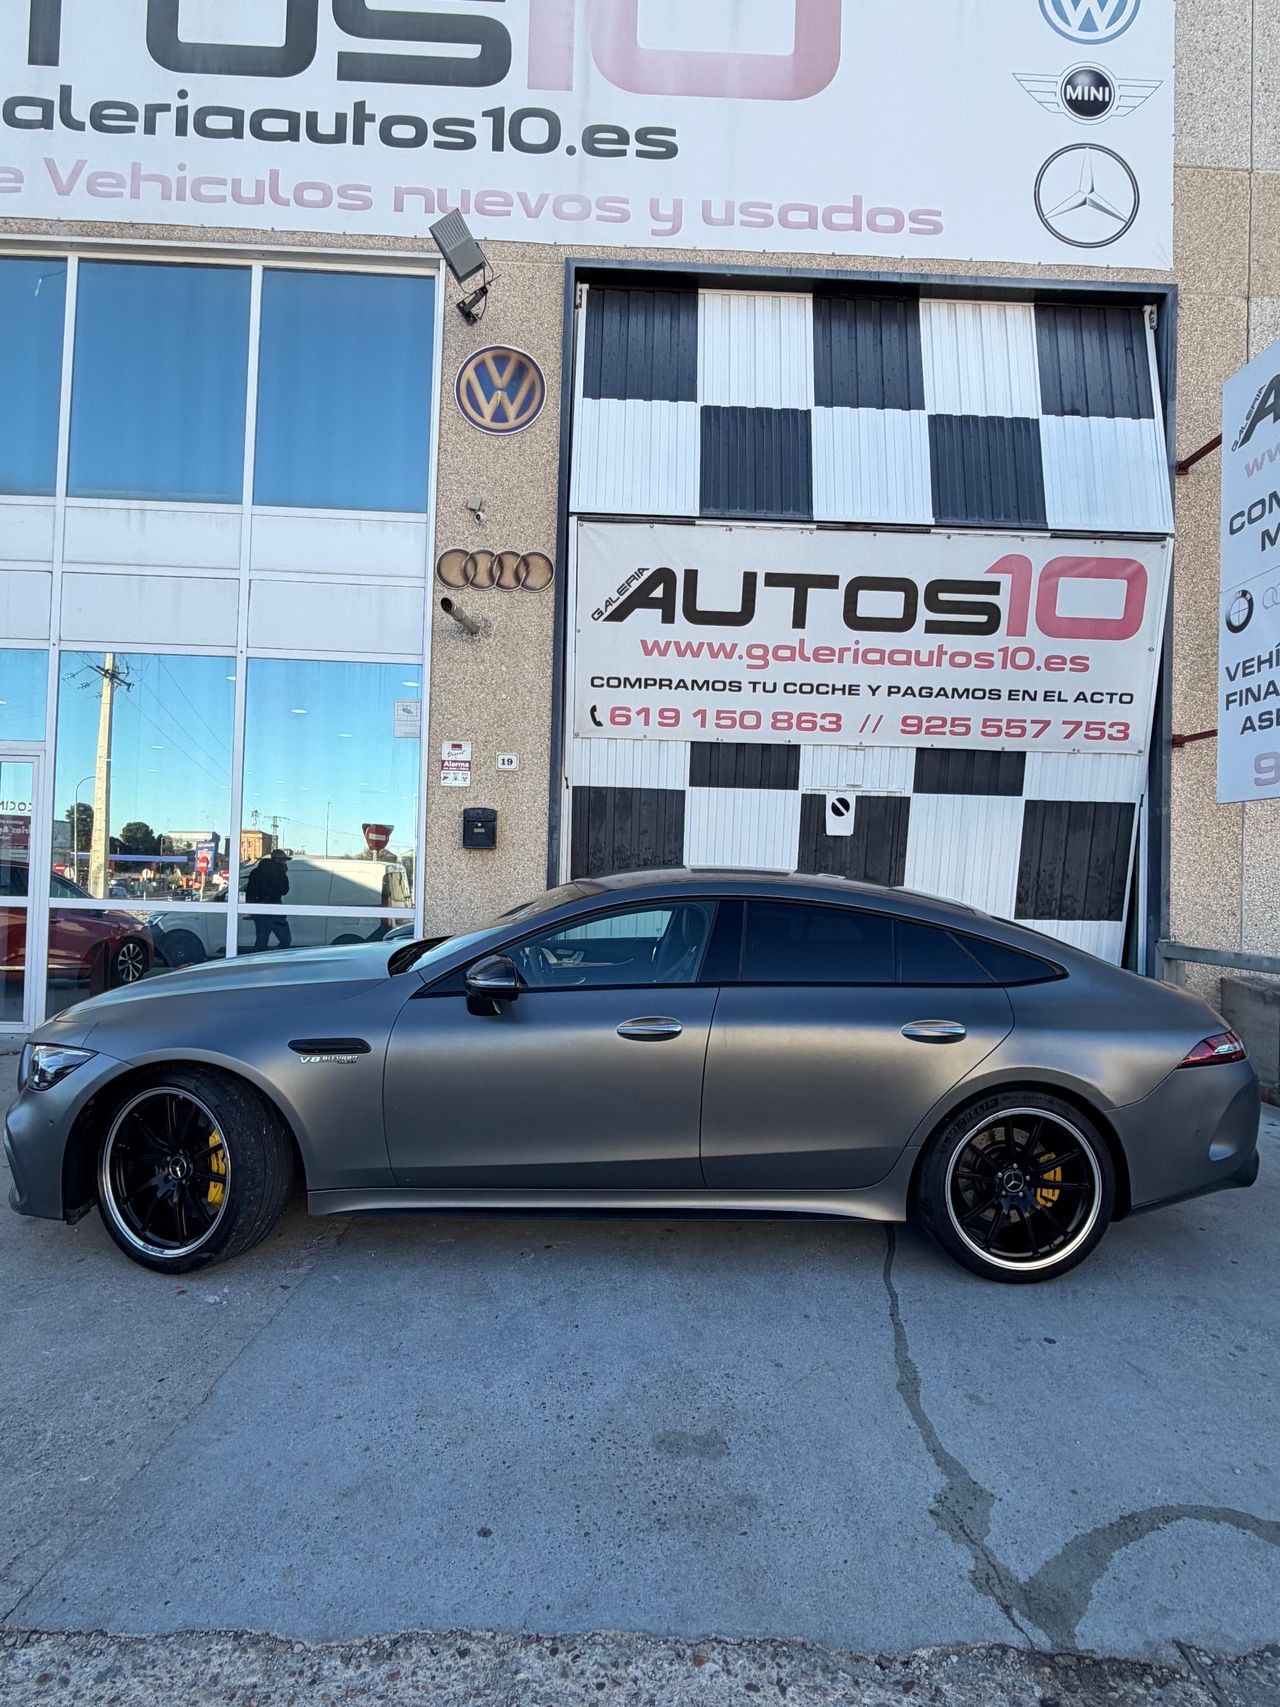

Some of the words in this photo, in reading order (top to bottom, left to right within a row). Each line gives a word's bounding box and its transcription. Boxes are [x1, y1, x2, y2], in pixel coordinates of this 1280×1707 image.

[1066, 84, 1110, 102] MINI
[43, 157, 374, 212] Vehiculos
[393, 185, 631, 223] nuevos
[649, 197, 684, 237] y
[701, 195, 944, 237] usados
[591, 567, 651, 623] GALERIA
[601, 553, 1148, 641] AUTOS10
[639, 638, 1090, 673] www.galeriaautos10.es
[590, 676, 742, 693] COMPRAMOS
[748, 681, 777, 694] TU
[783, 682, 860, 697] COCHE
[867, 685, 882, 697] Y
[887, 685, 1002, 701] PAGAMOS
[1007, 689, 1037, 702] EN
[1044, 690, 1068, 703] EL
[1073, 691, 1135, 704] ACTO
[609, 706, 681, 728] 619
[692, 708, 762, 730] 150
[770, 711, 842, 733] 863
[900, 715, 971, 737] 925
[980, 718, 1051, 739] 557
[1061, 720, 1131, 741] 753
[501, 757, 513, 766] 19
